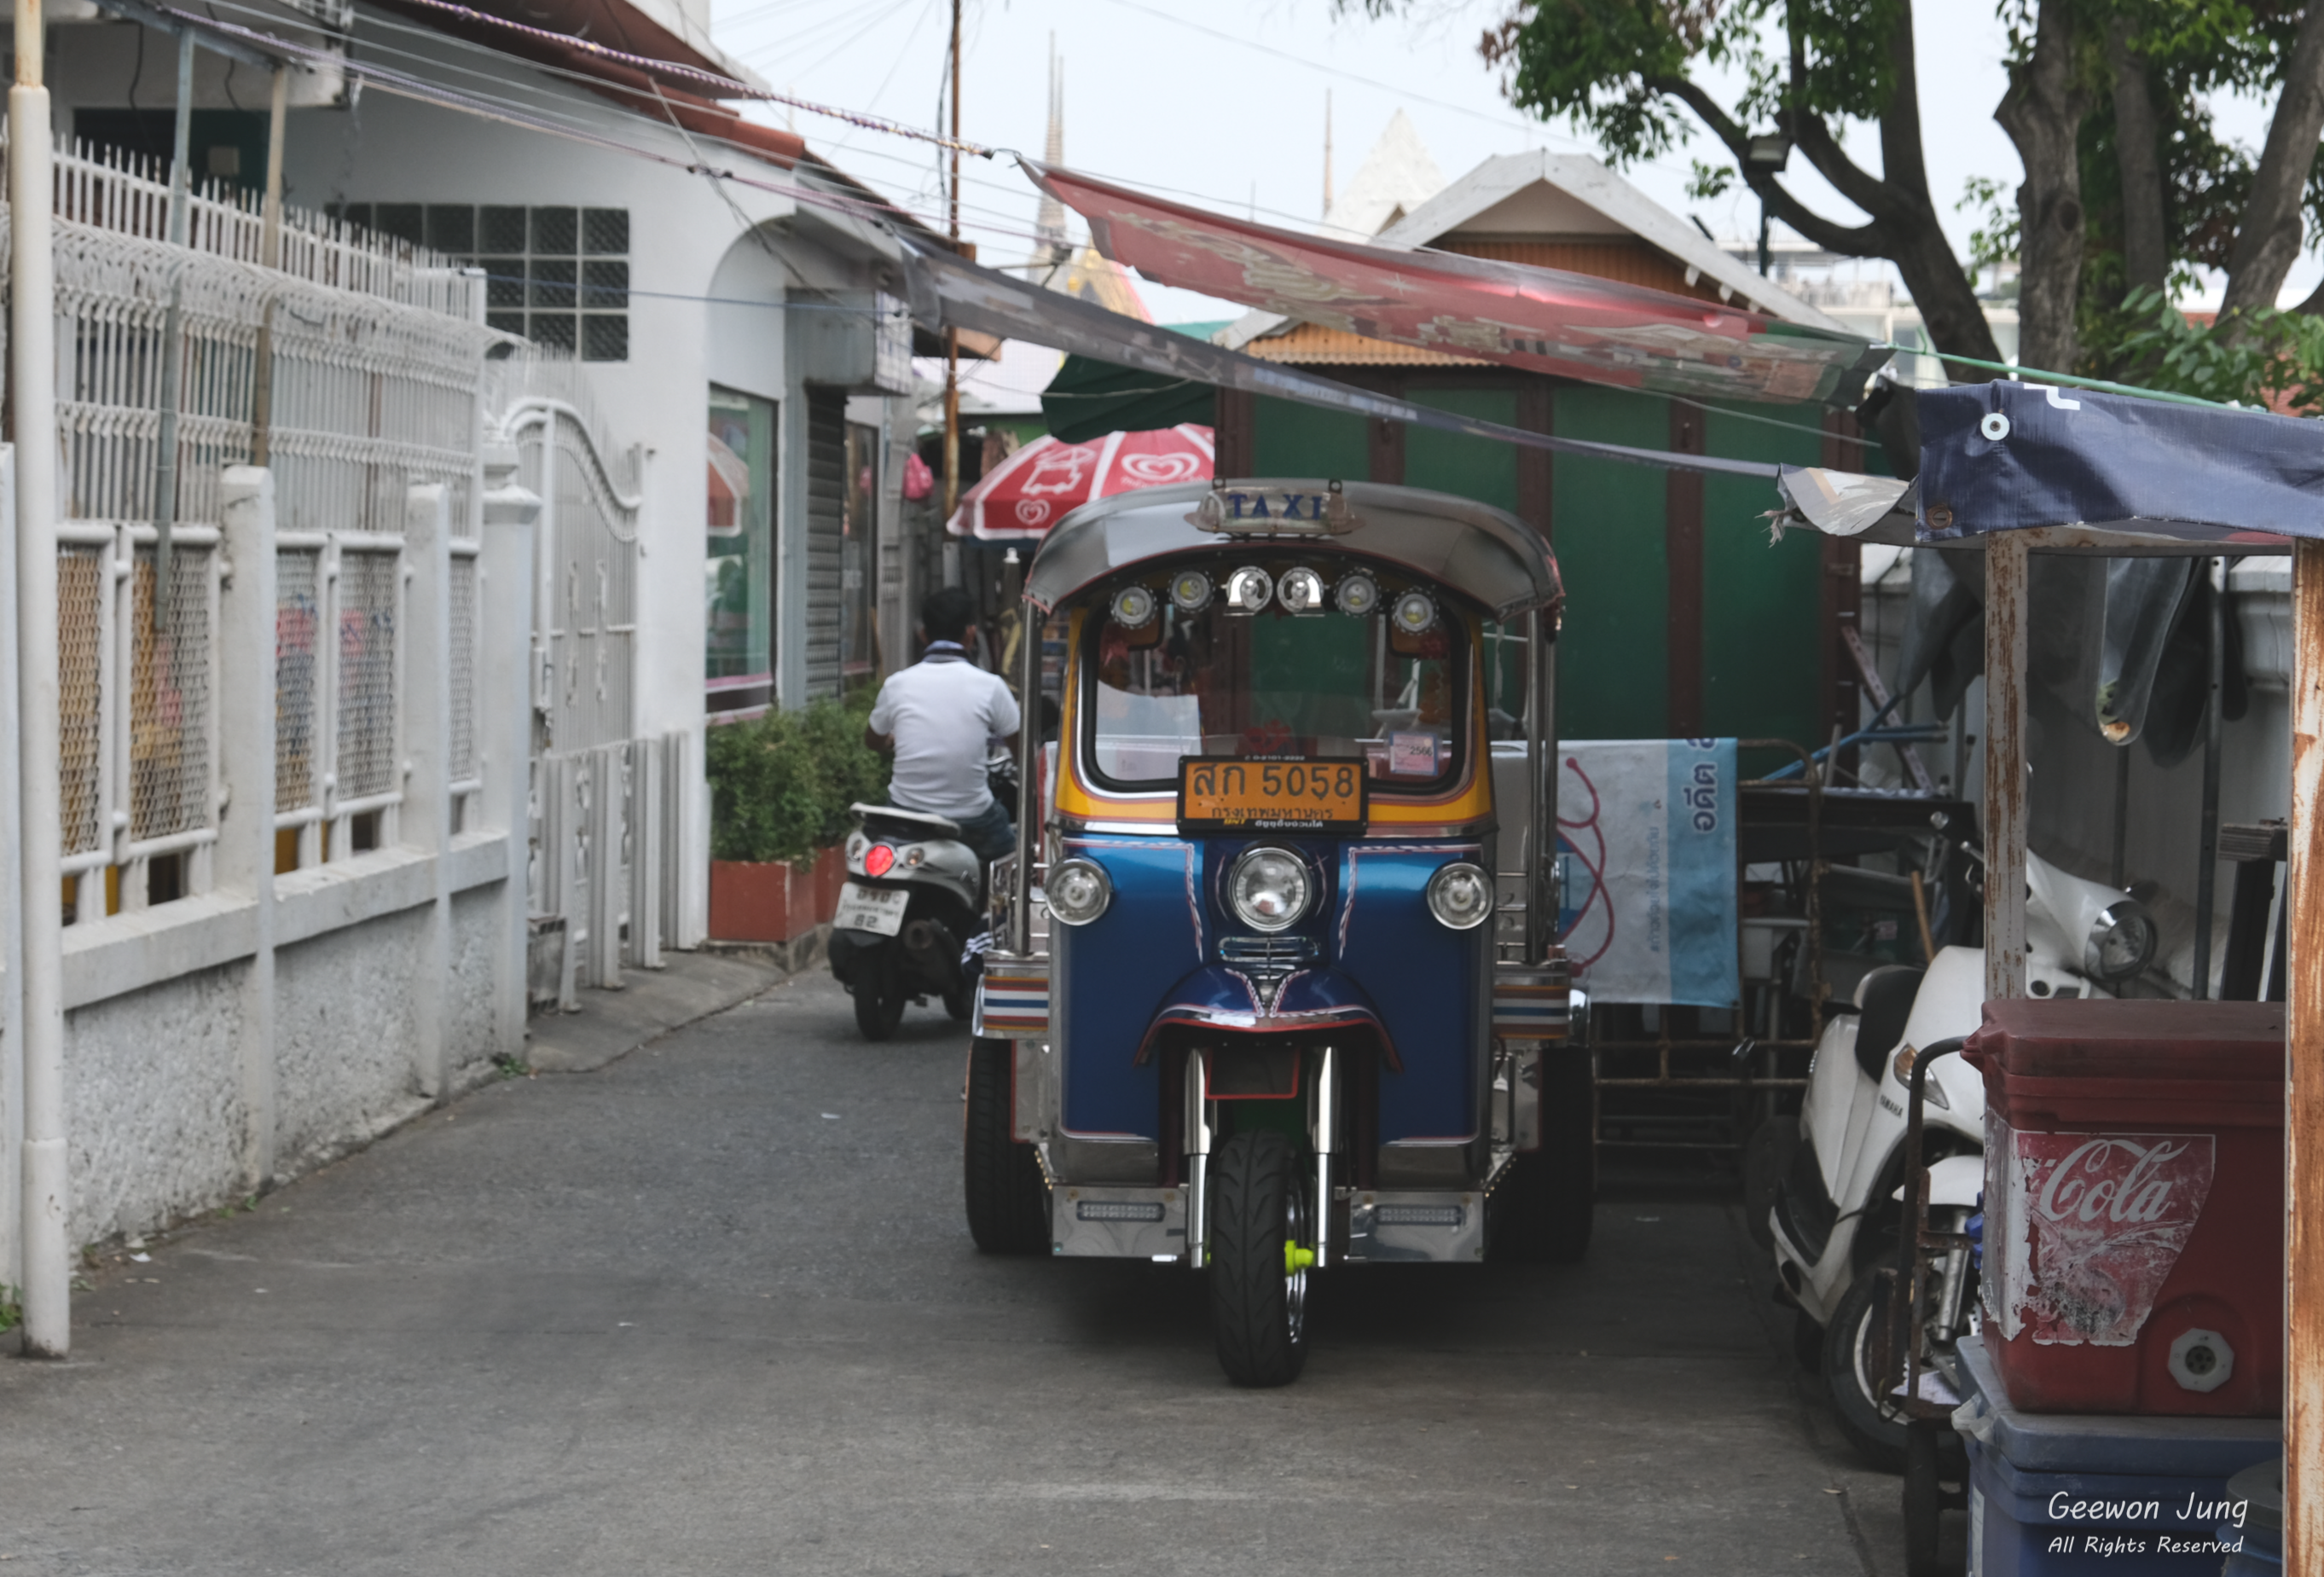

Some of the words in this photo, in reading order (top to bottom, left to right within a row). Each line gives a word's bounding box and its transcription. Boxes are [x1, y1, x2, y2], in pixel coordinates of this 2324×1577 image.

[1227, 494, 1323, 520] TAXI
[1193, 764, 1245, 796] สก
[1263, 766, 1353, 798] 5058
[1684, 762, 1716, 832] อดีต
[1880, 1094, 1904, 1118] YAMAHA
